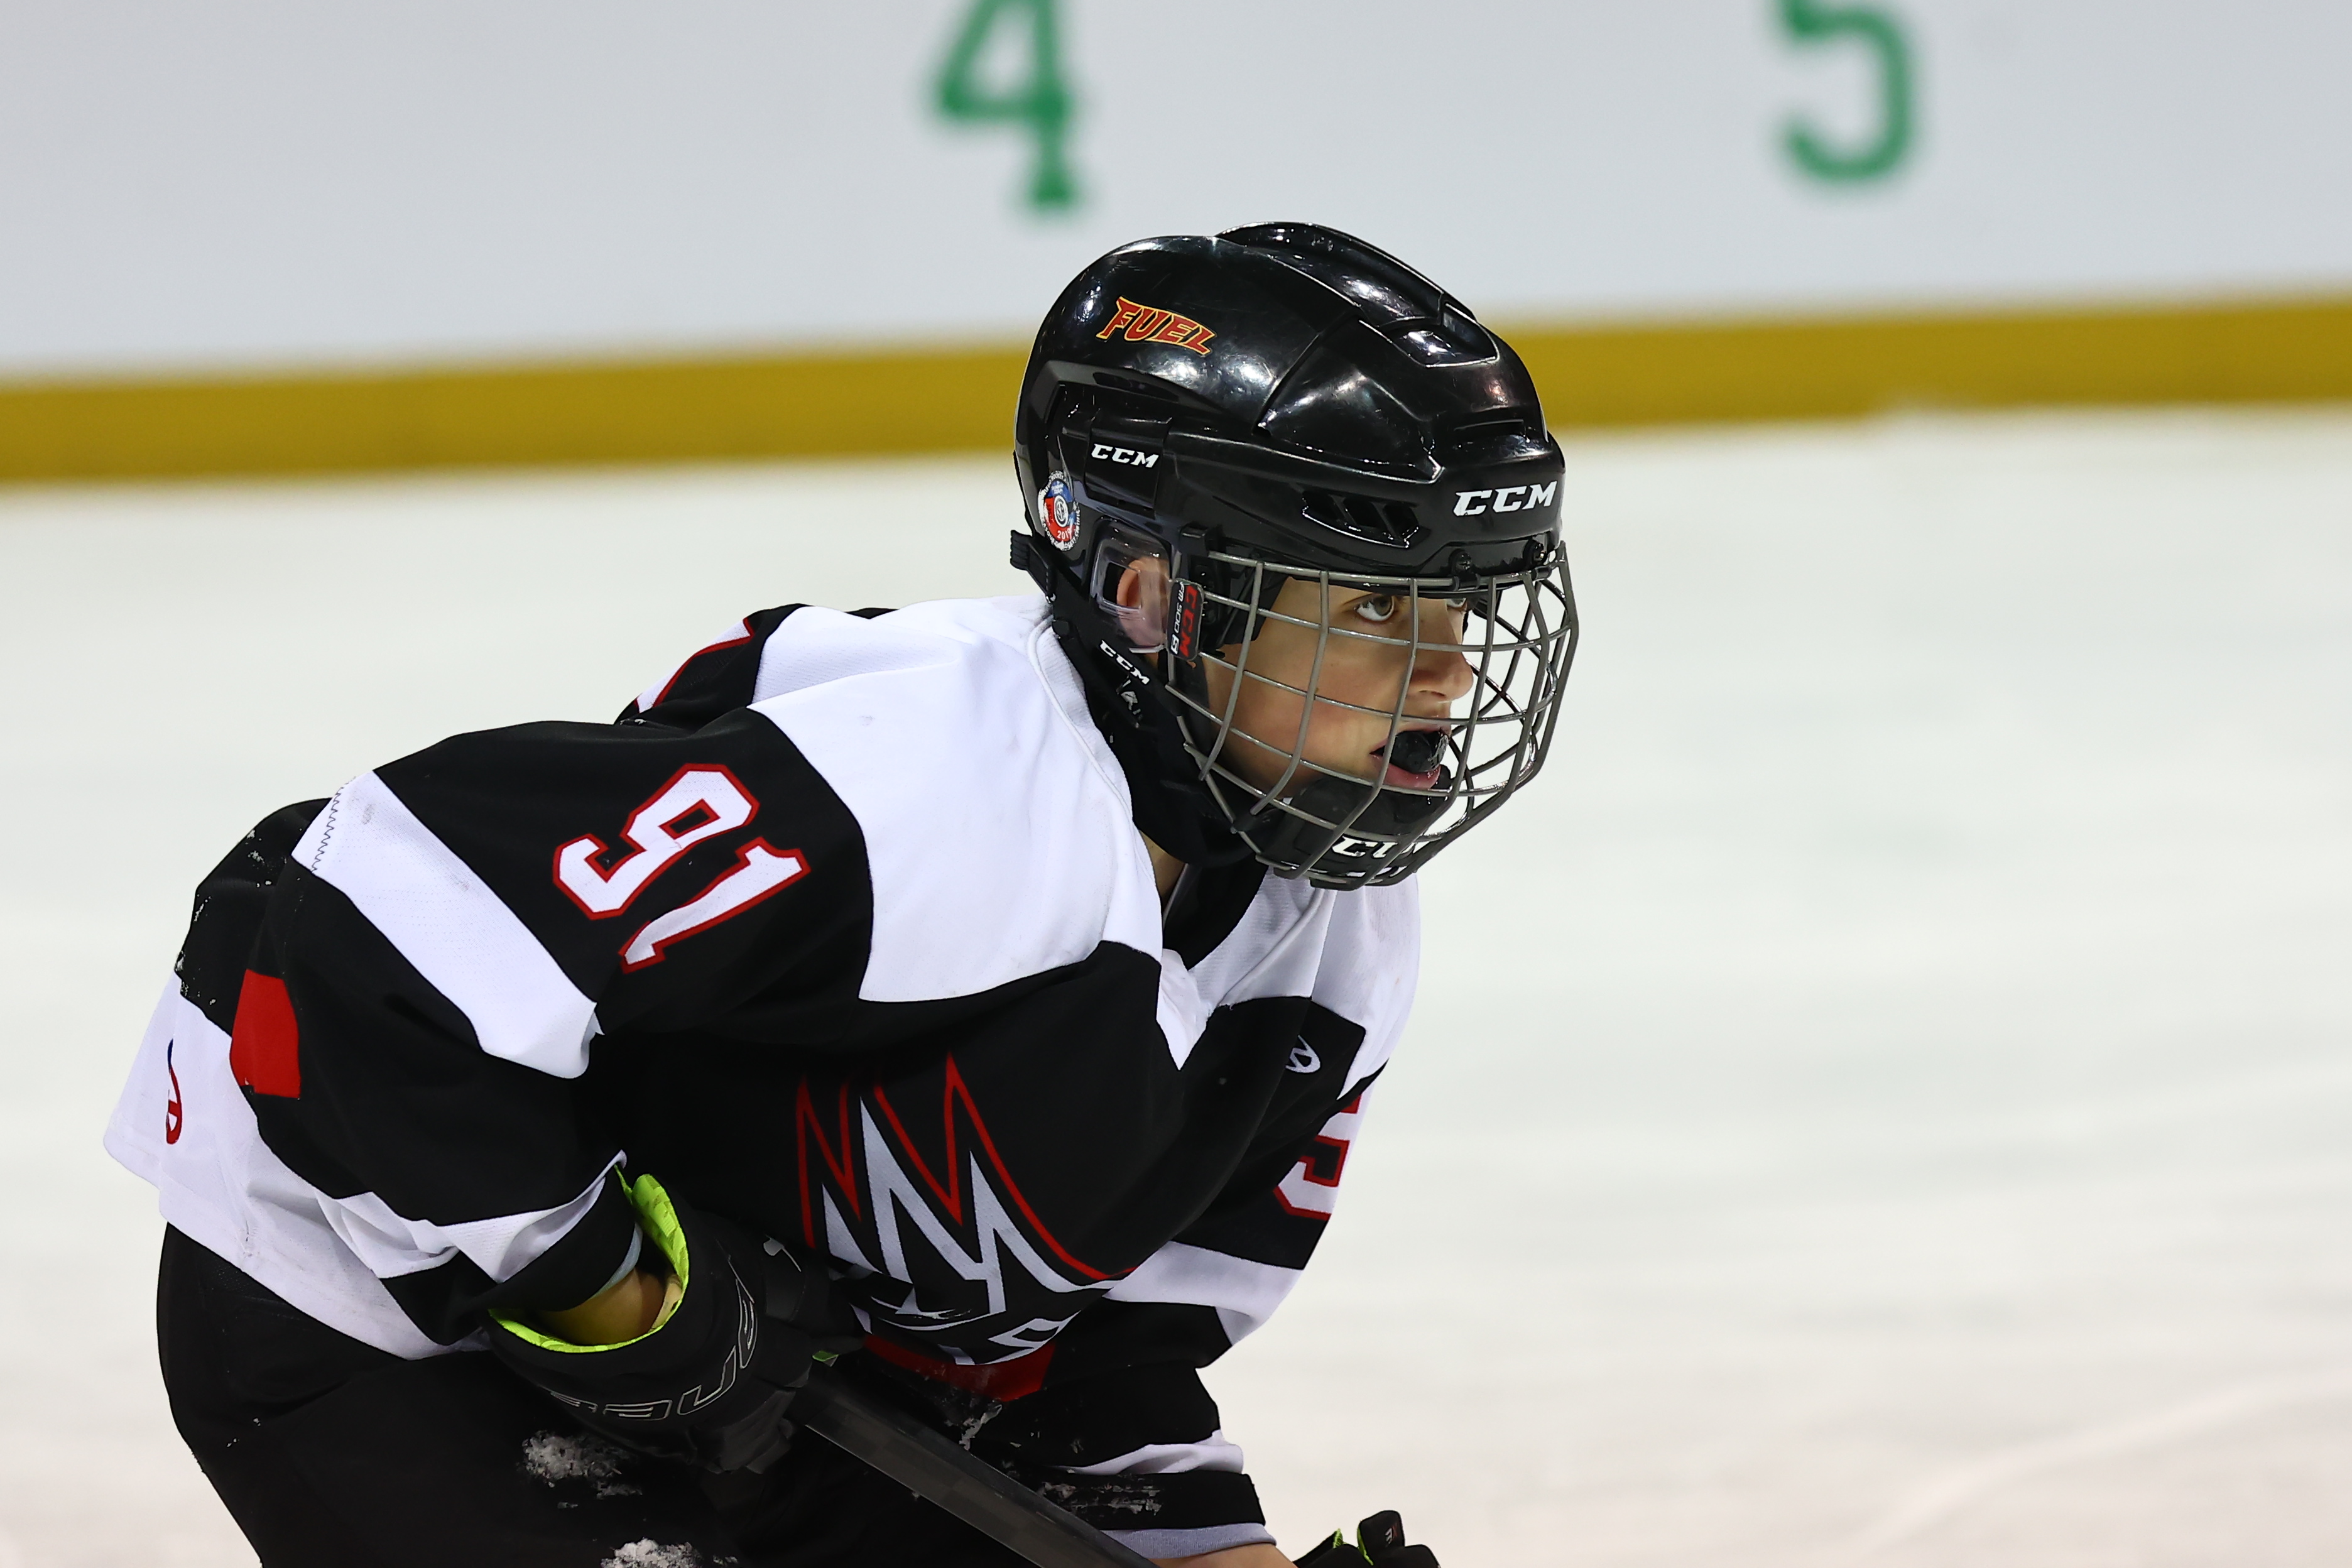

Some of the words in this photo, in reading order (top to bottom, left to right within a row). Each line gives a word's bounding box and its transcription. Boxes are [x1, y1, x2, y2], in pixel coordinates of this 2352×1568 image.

[934, 0, 1081, 211] 4
[1780, 0, 1917, 190] 5
[1096, 296, 1216, 355] FUEL
[1091, 443, 1159, 468] CCM
[1452, 481, 1558, 516] CCM
[1174, 602, 1182, 634] 500
[1179, 585, 1198, 657] CCM
[1100, 640, 1150, 685] CCM
[553, 763, 812, 974] 91
